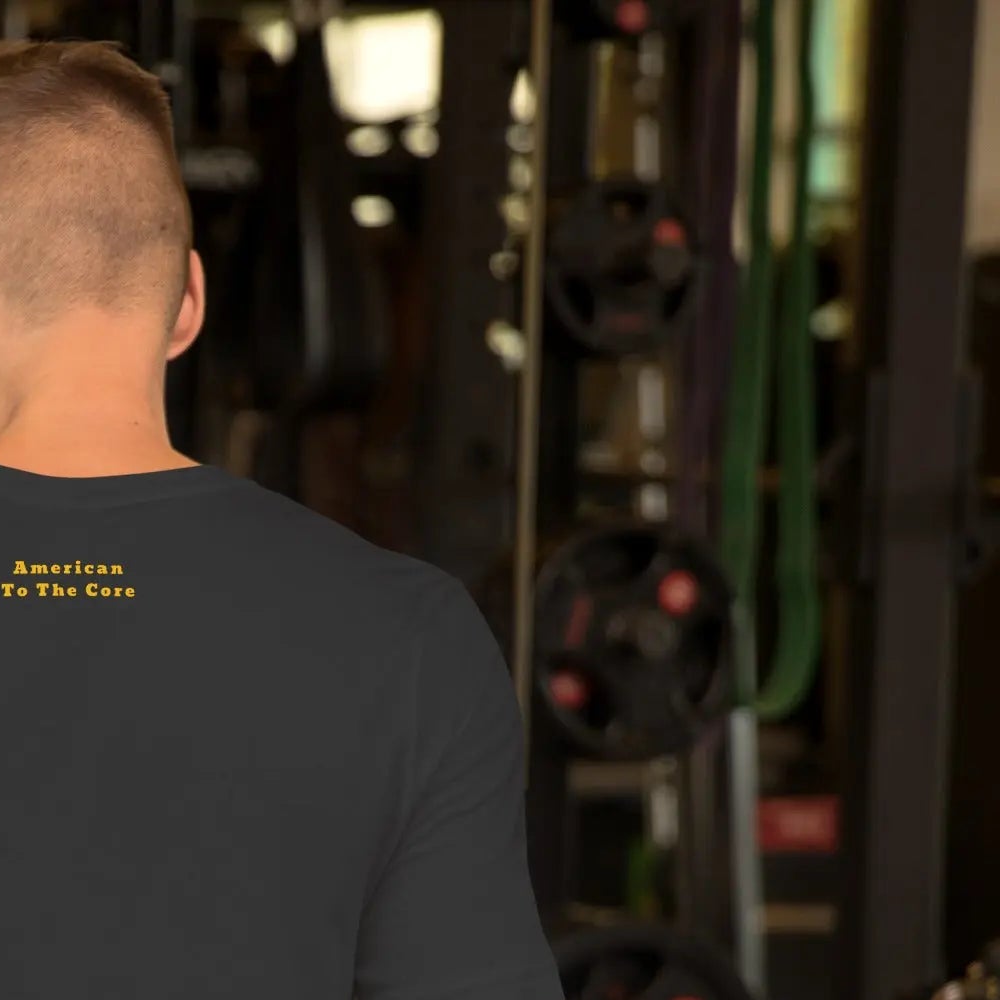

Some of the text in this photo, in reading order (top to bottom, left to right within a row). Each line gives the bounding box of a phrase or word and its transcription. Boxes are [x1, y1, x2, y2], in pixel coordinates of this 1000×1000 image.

[13, 560, 124, 575] American
[1, 582, 135, 598] To The Core
